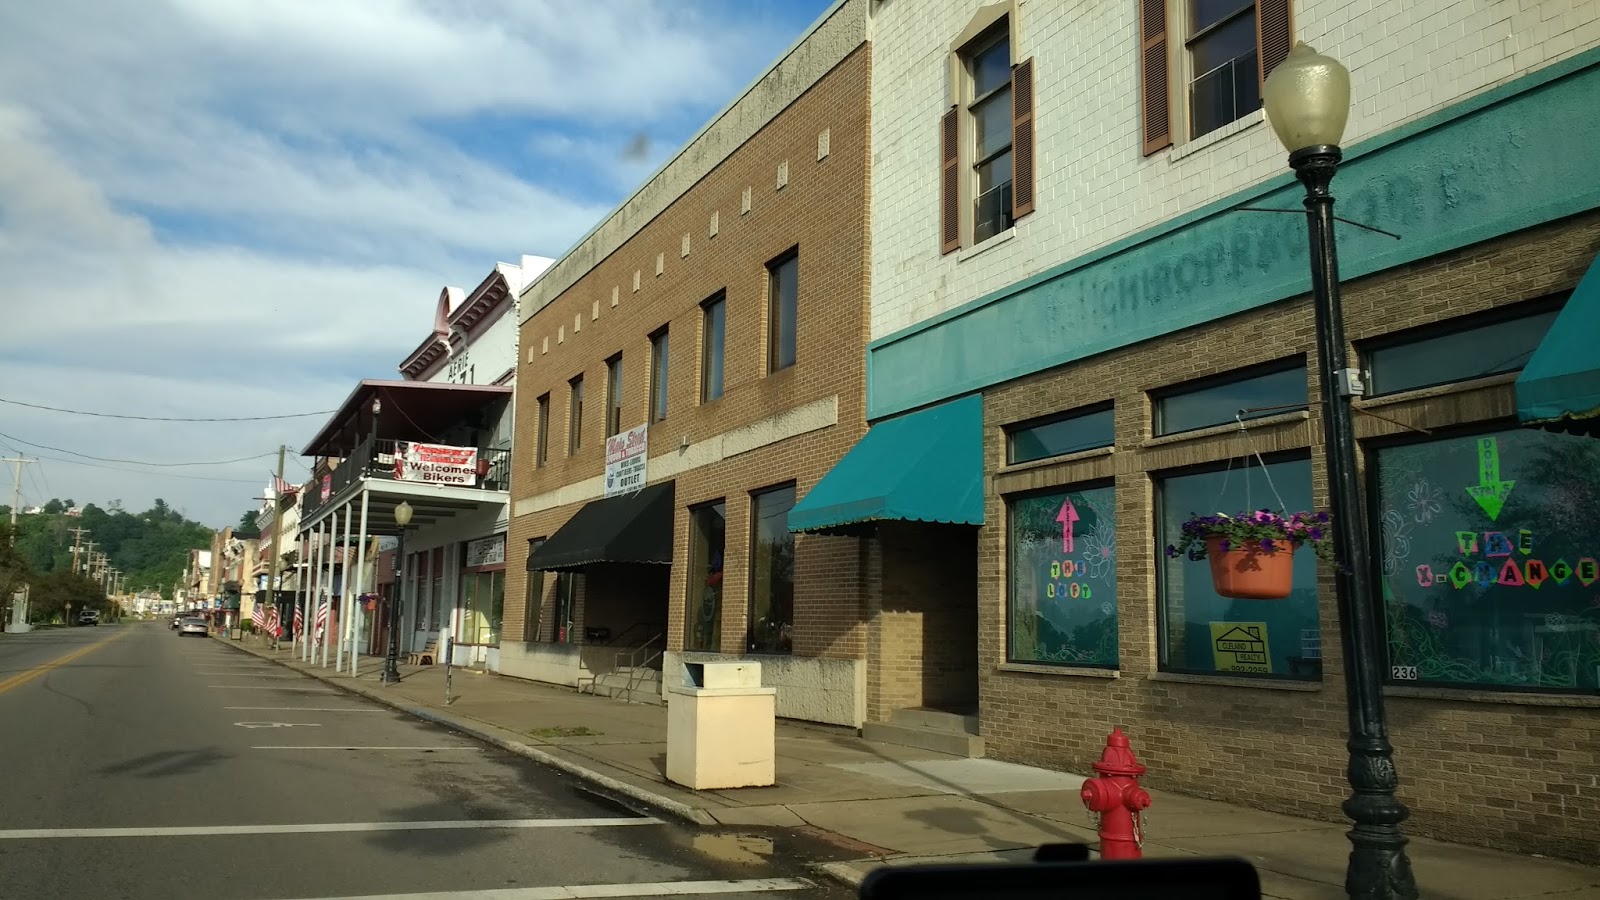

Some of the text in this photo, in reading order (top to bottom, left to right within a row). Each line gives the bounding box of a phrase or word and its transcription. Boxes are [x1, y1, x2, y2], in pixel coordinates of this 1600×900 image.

[1483, 438, 1494, 482] DOWN
[409, 461, 477, 475] Welcomes
[423, 472, 465, 483] Bikers
[620, 474, 640, 487] OUTLET
[1460, 532, 1532, 552] THE
[1052, 562, 1085, 577] THE
[1418, 561, 1595, 585] X-CHANGE
[1048, 583, 1090, 598] LOFT
[1222, 642, 1246, 650] CLELAND
[1240, 653, 1261, 661] REALTY
[1231, 665, 1268, 673] 992-2259
[1393, 667, 1416, 679] 236
